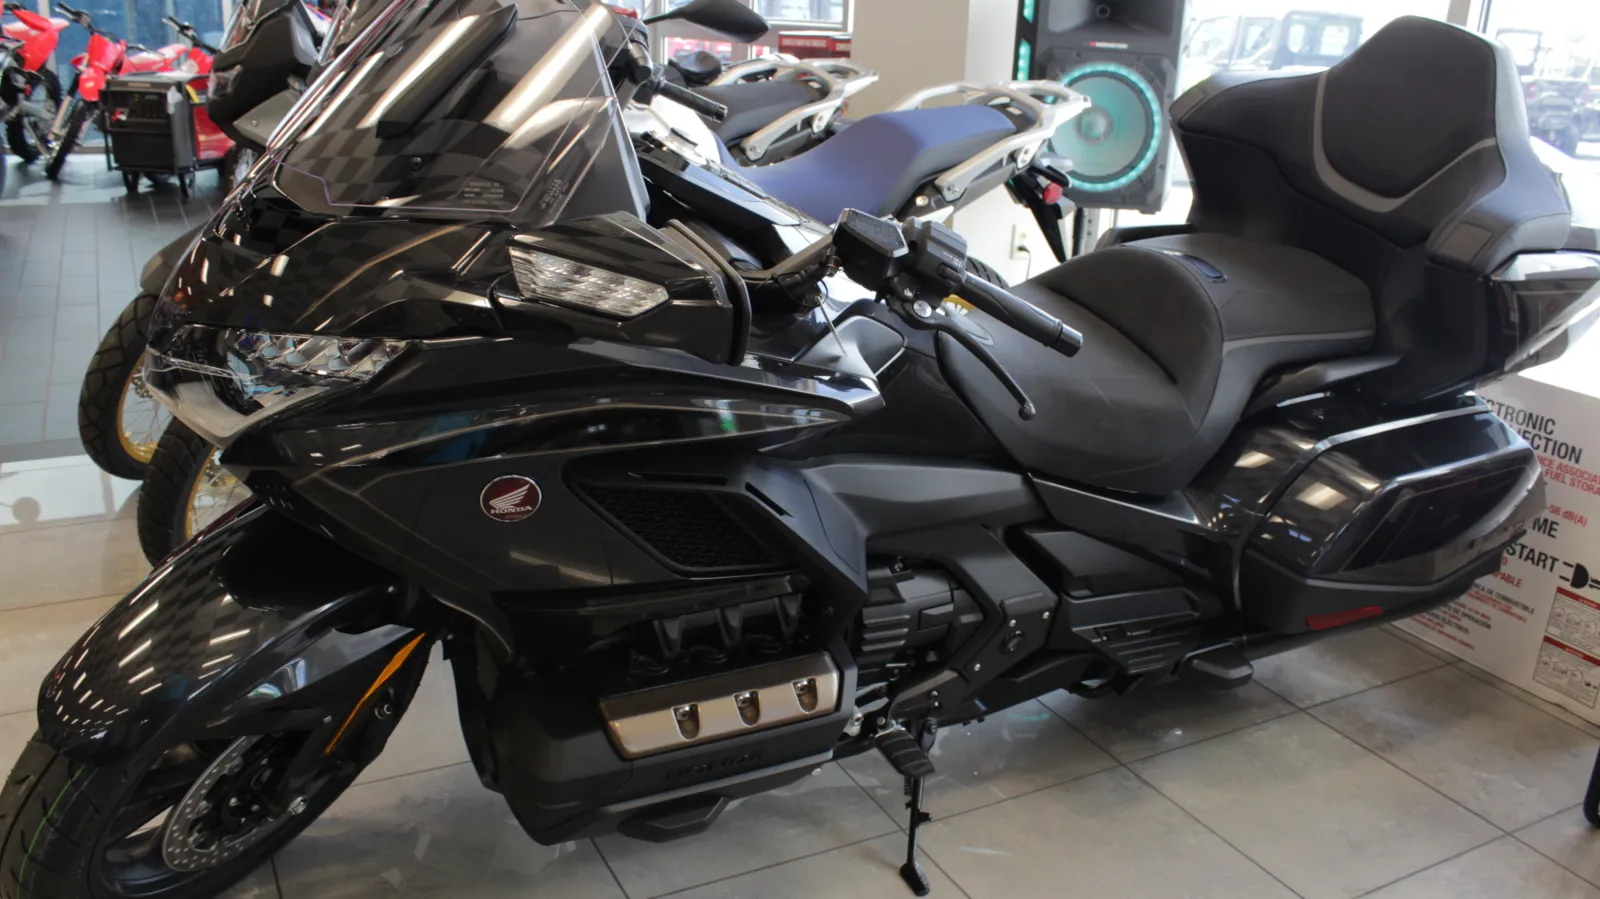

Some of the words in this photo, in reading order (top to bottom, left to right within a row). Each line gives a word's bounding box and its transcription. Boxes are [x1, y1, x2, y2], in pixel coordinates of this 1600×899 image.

[1481, 397, 1556, 436] CTRONIC
[1517, 427, 1582, 465] ECTION
[1544, 468, 1567, 485] FUEL
[1555, 461, 1600, 486] ASSOCIA
[490, 505, 533, 514] HONDA
[1505, 541, 1560, 574] START
